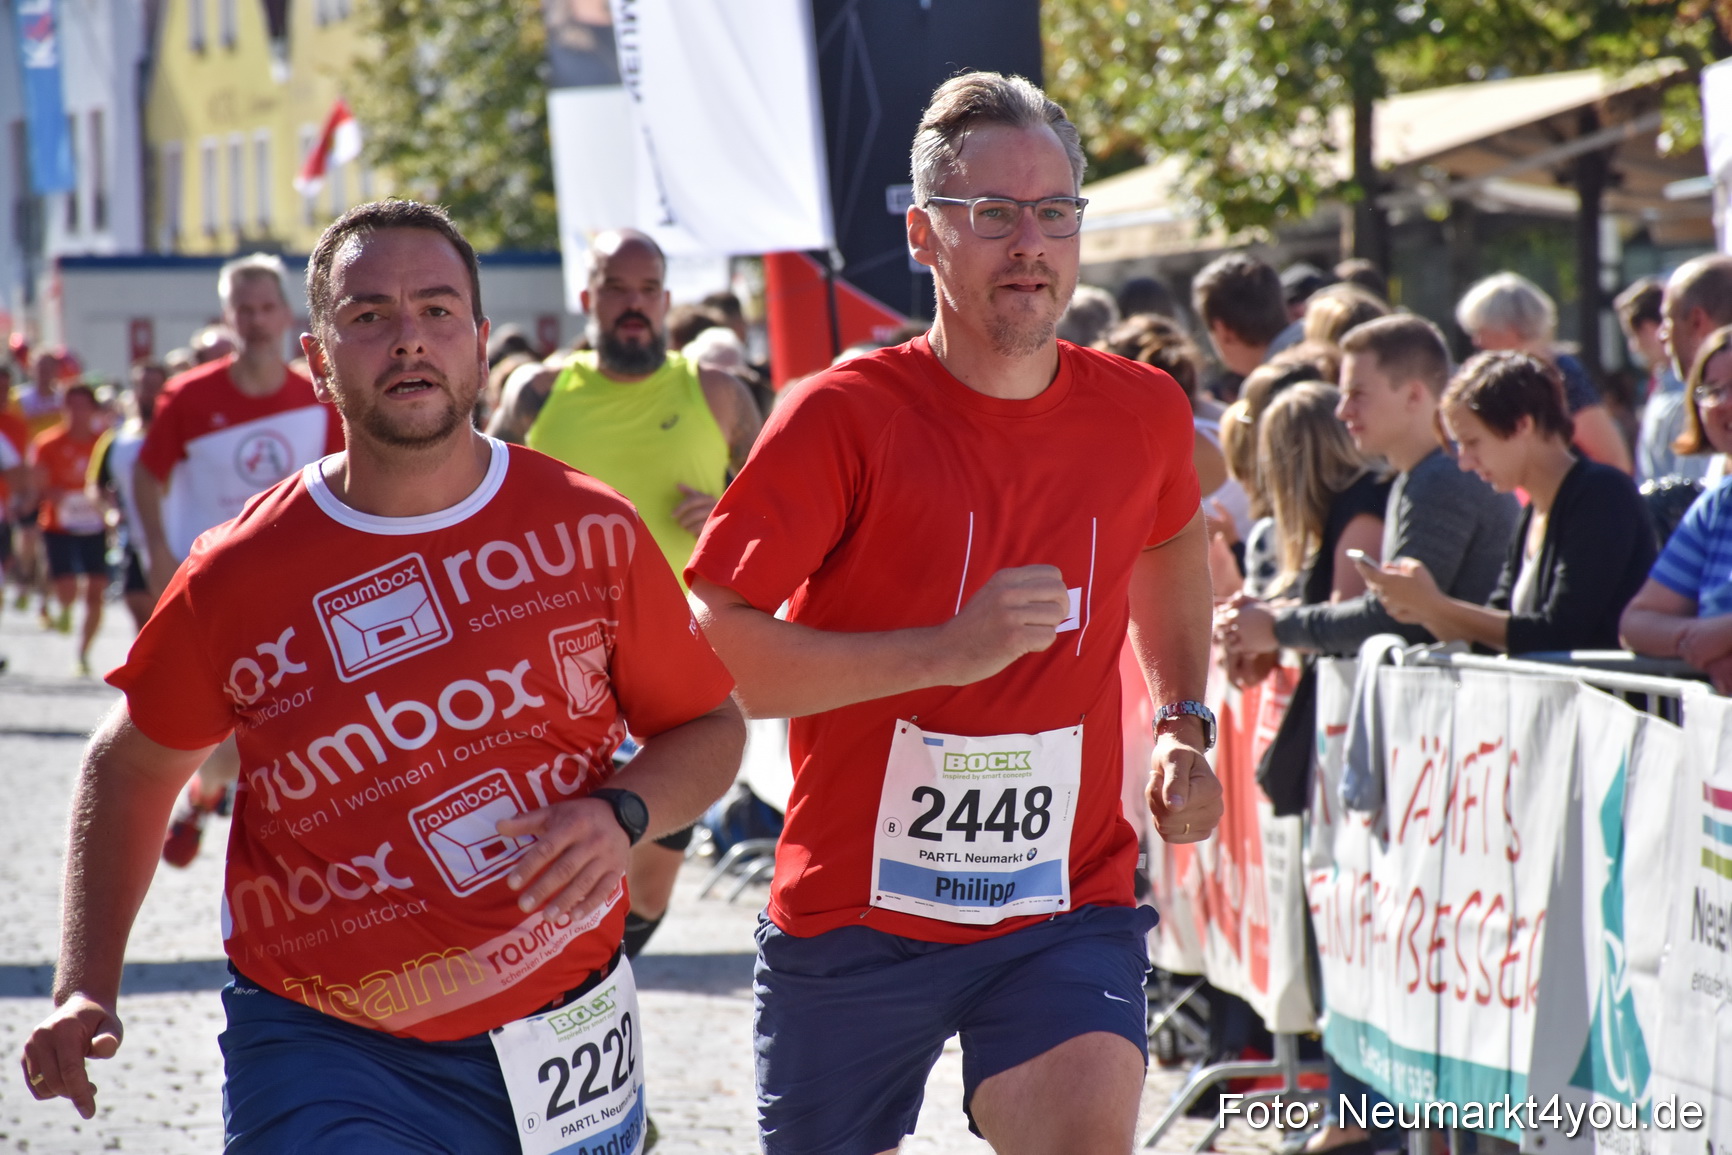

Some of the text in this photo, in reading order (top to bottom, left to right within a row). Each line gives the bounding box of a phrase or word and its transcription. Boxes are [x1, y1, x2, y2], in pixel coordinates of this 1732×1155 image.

[323, 565, 419, 615] raumbox
[468, 590, 580, 632] schenken
[943, 751, 1032, 773] BOCK
[1003, 771, 1032, 779] concepts
[344, 761, 434, 811] wohnen
[419, 779, 506, 832] raumbox
[907, 785, 1053, 842] 2448
[888, 821, 896, 833] B
[919, 849, 1023, 864] PARTL Neumarkt
[221, 841, 415, 940] mbox
[935, 876, 1016, 905] Philipp
[342, 899, 429, 934] outdoor
[283, 947, 484, 1021] Team
[500, 958, 539, 986] schenken
[537, 1011, 636, 1121] 2222
[527, 1117, 535, 1130] D
[560, 1114, 600, 1138] PARTL
